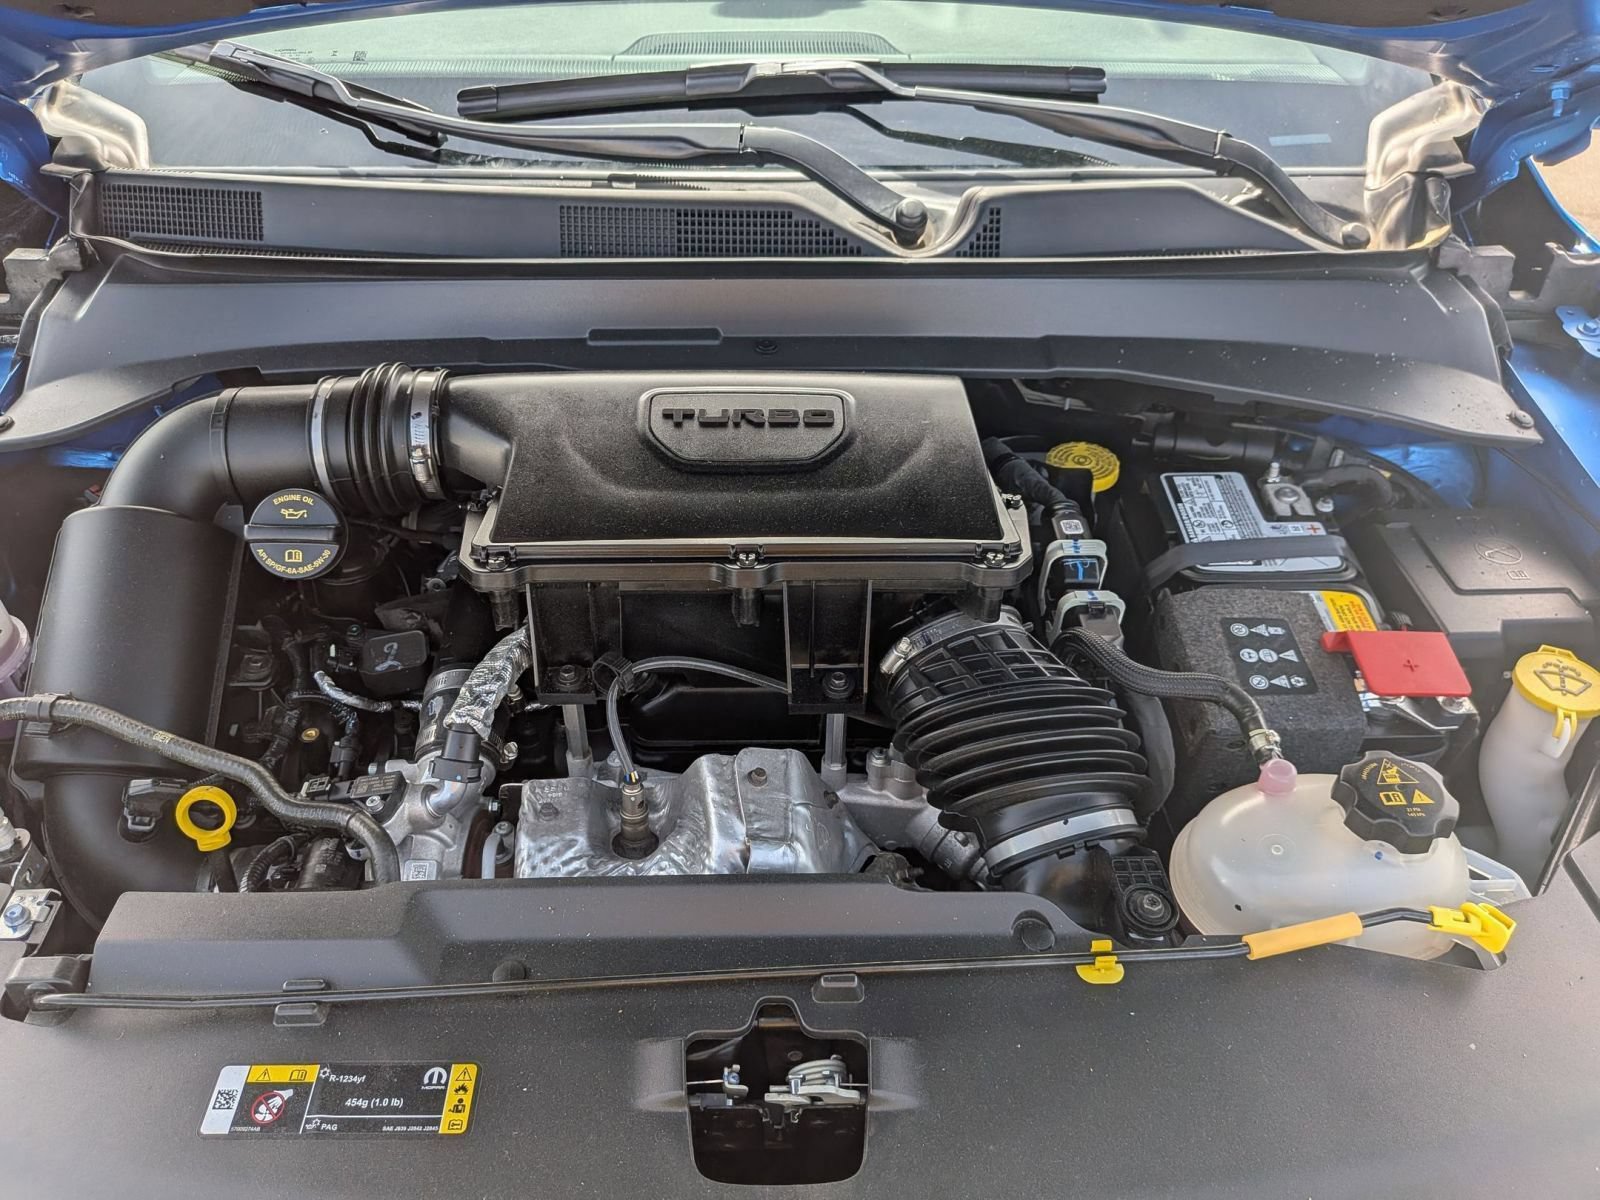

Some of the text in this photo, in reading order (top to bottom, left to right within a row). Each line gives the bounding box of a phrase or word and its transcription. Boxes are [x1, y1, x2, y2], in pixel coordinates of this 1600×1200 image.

[662, 408, 835, 427] TURBO
[272, 494, 315, 506] ENGINE OIL
[256, 548, 266, 561] API
[329, 1074, 366, 1084] R-1234yf
[344, 1097, 404, 1109] 454g (1.0 lb)
[320, 1123, 338, 1131] PAG
